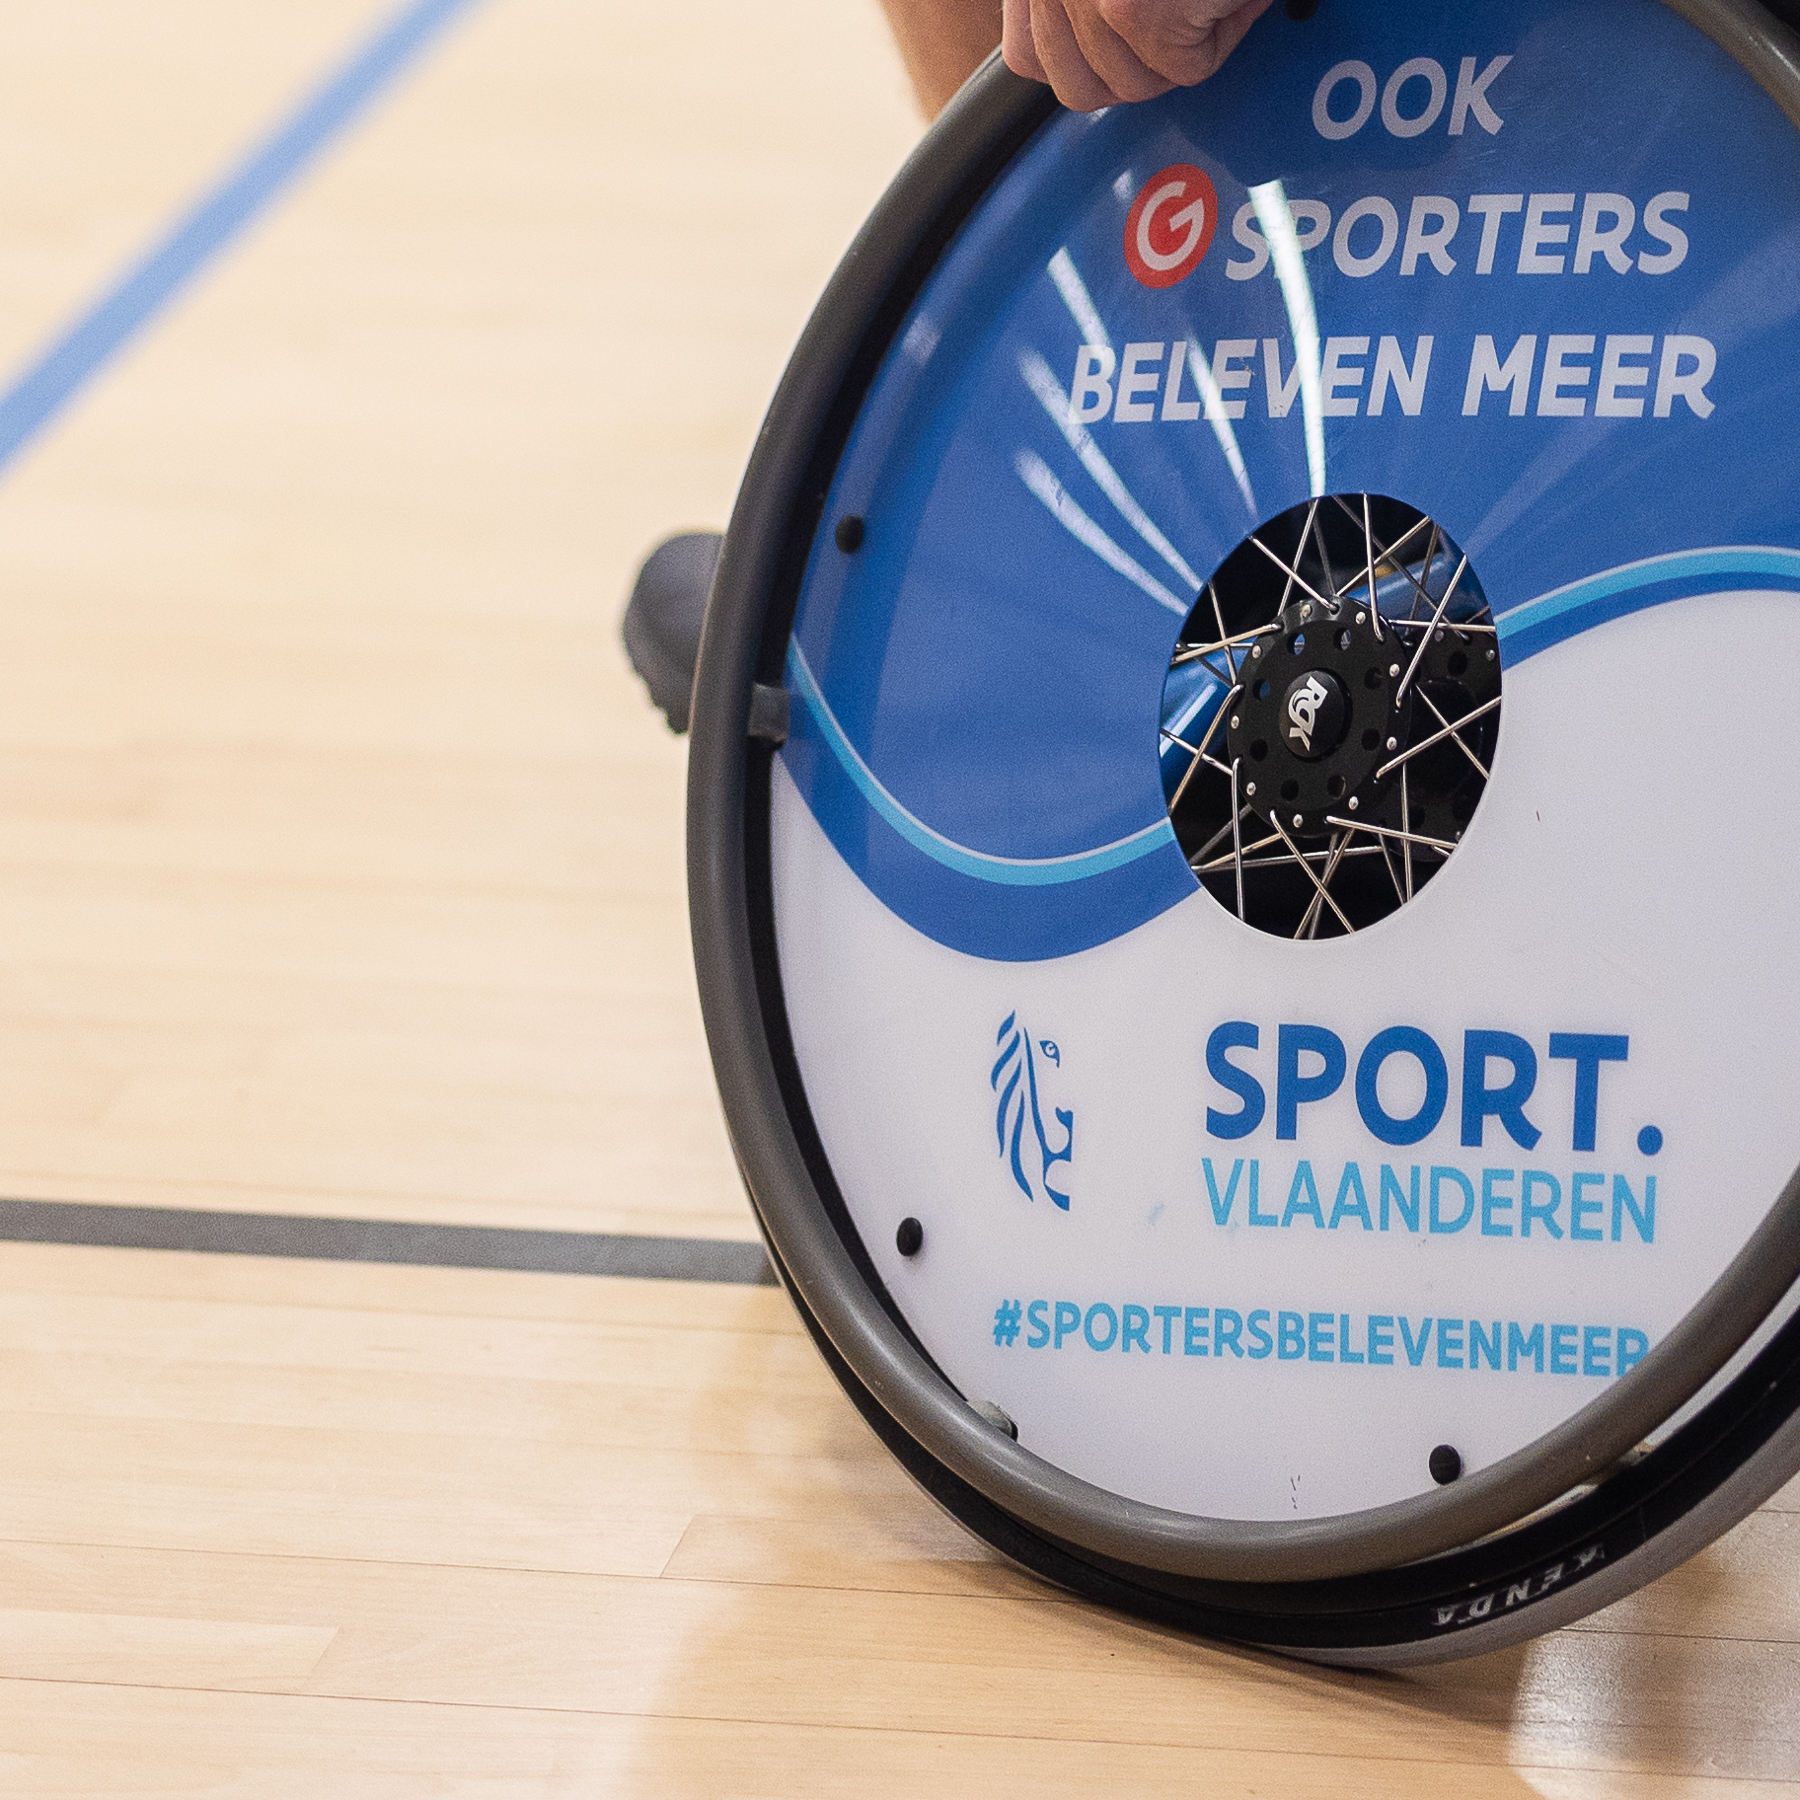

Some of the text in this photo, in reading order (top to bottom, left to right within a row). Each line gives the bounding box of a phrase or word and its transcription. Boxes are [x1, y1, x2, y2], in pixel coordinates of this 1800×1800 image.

[1311, 55, 1514, 141] OOK
[1224, 191, 1691, 282] SPORTERS
[1068, 334, 1717, 425] BELEVEN MEER
[1205, 1020, 1664, 1156] SPORT.
[1201, 1156, 1658, 1244] VLAANDEREN
[992, 1298, 1650, 1378] #SPORTERSBELEVENMEER
